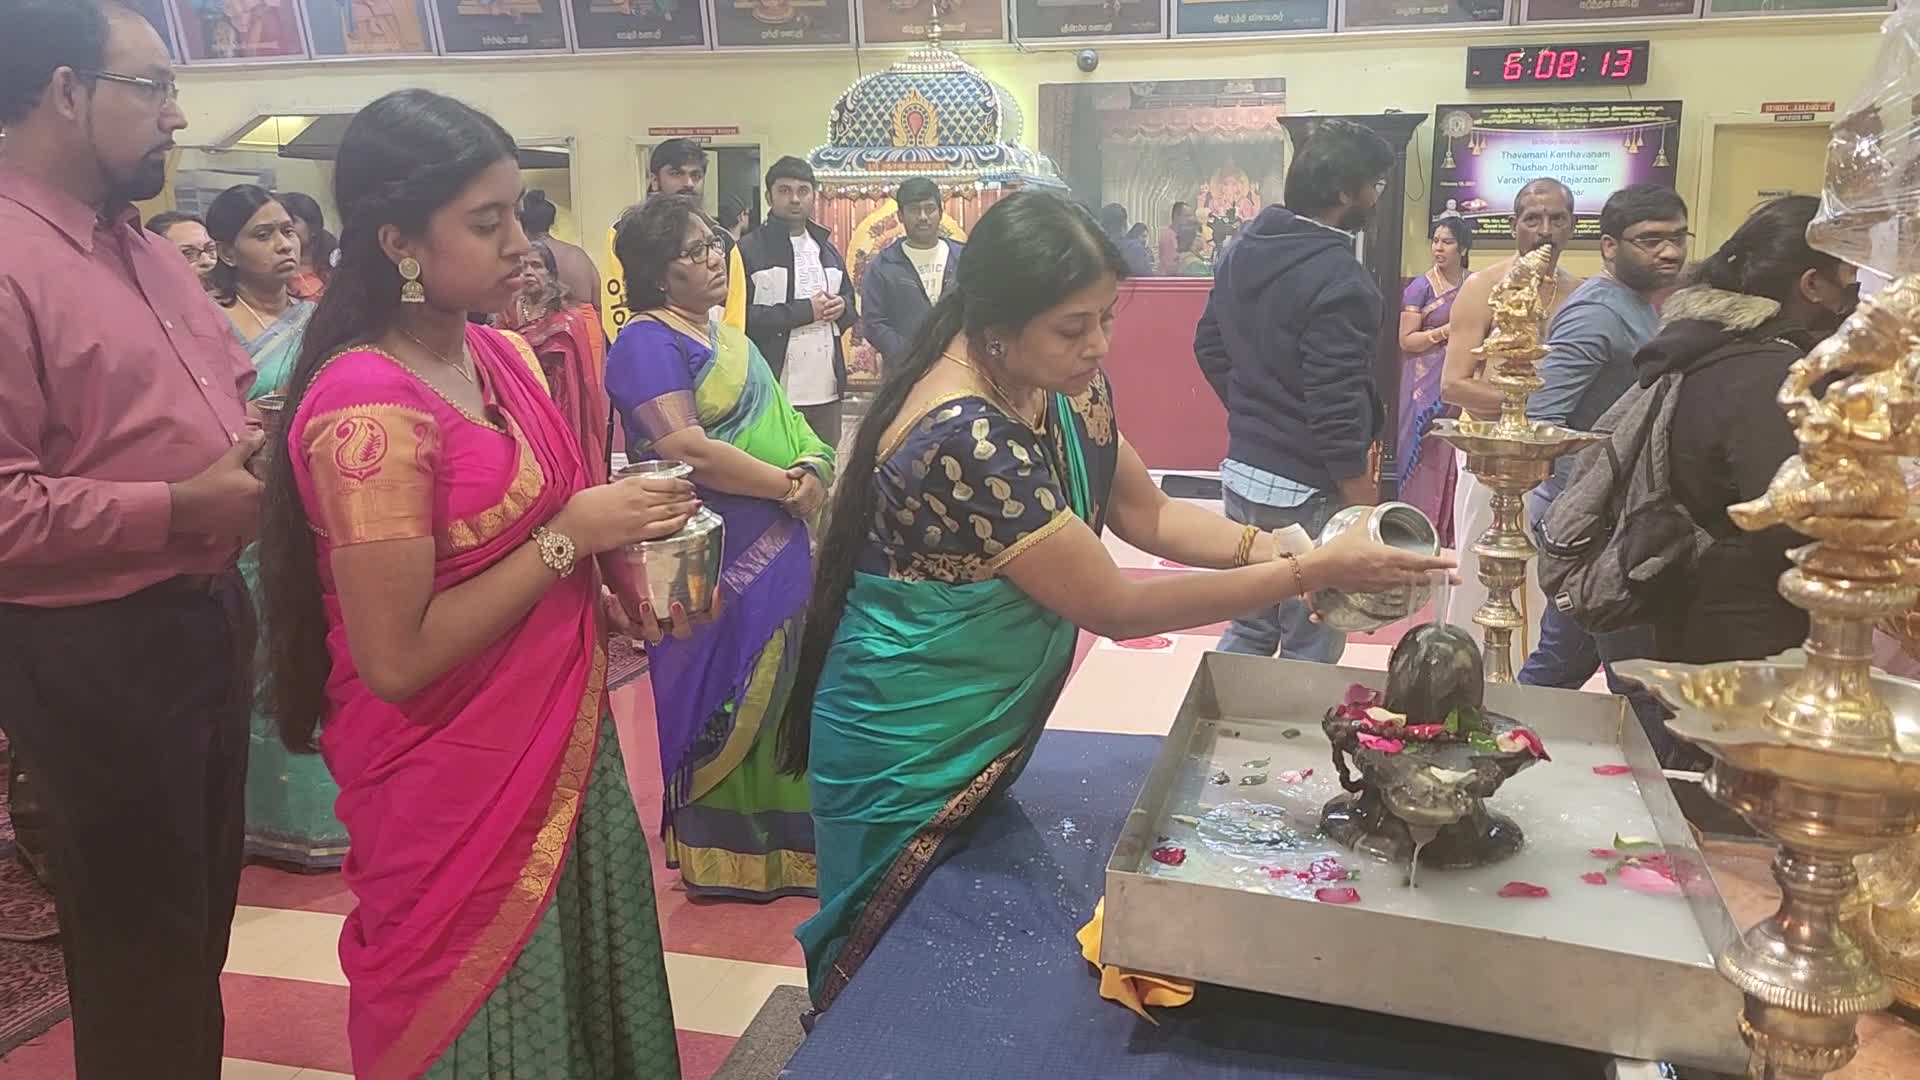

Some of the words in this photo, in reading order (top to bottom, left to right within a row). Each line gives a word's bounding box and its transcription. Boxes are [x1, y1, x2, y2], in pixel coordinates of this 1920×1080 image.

[1502, 151, 1547, 159] Thavamani
[1512, 163, 1548, 171] Thushan
[1551, 162, 1598, 171] Jothikumar
[1561, 175, 1611, 185] Rajaratnam
[607, 278, 626, 335] OLO
